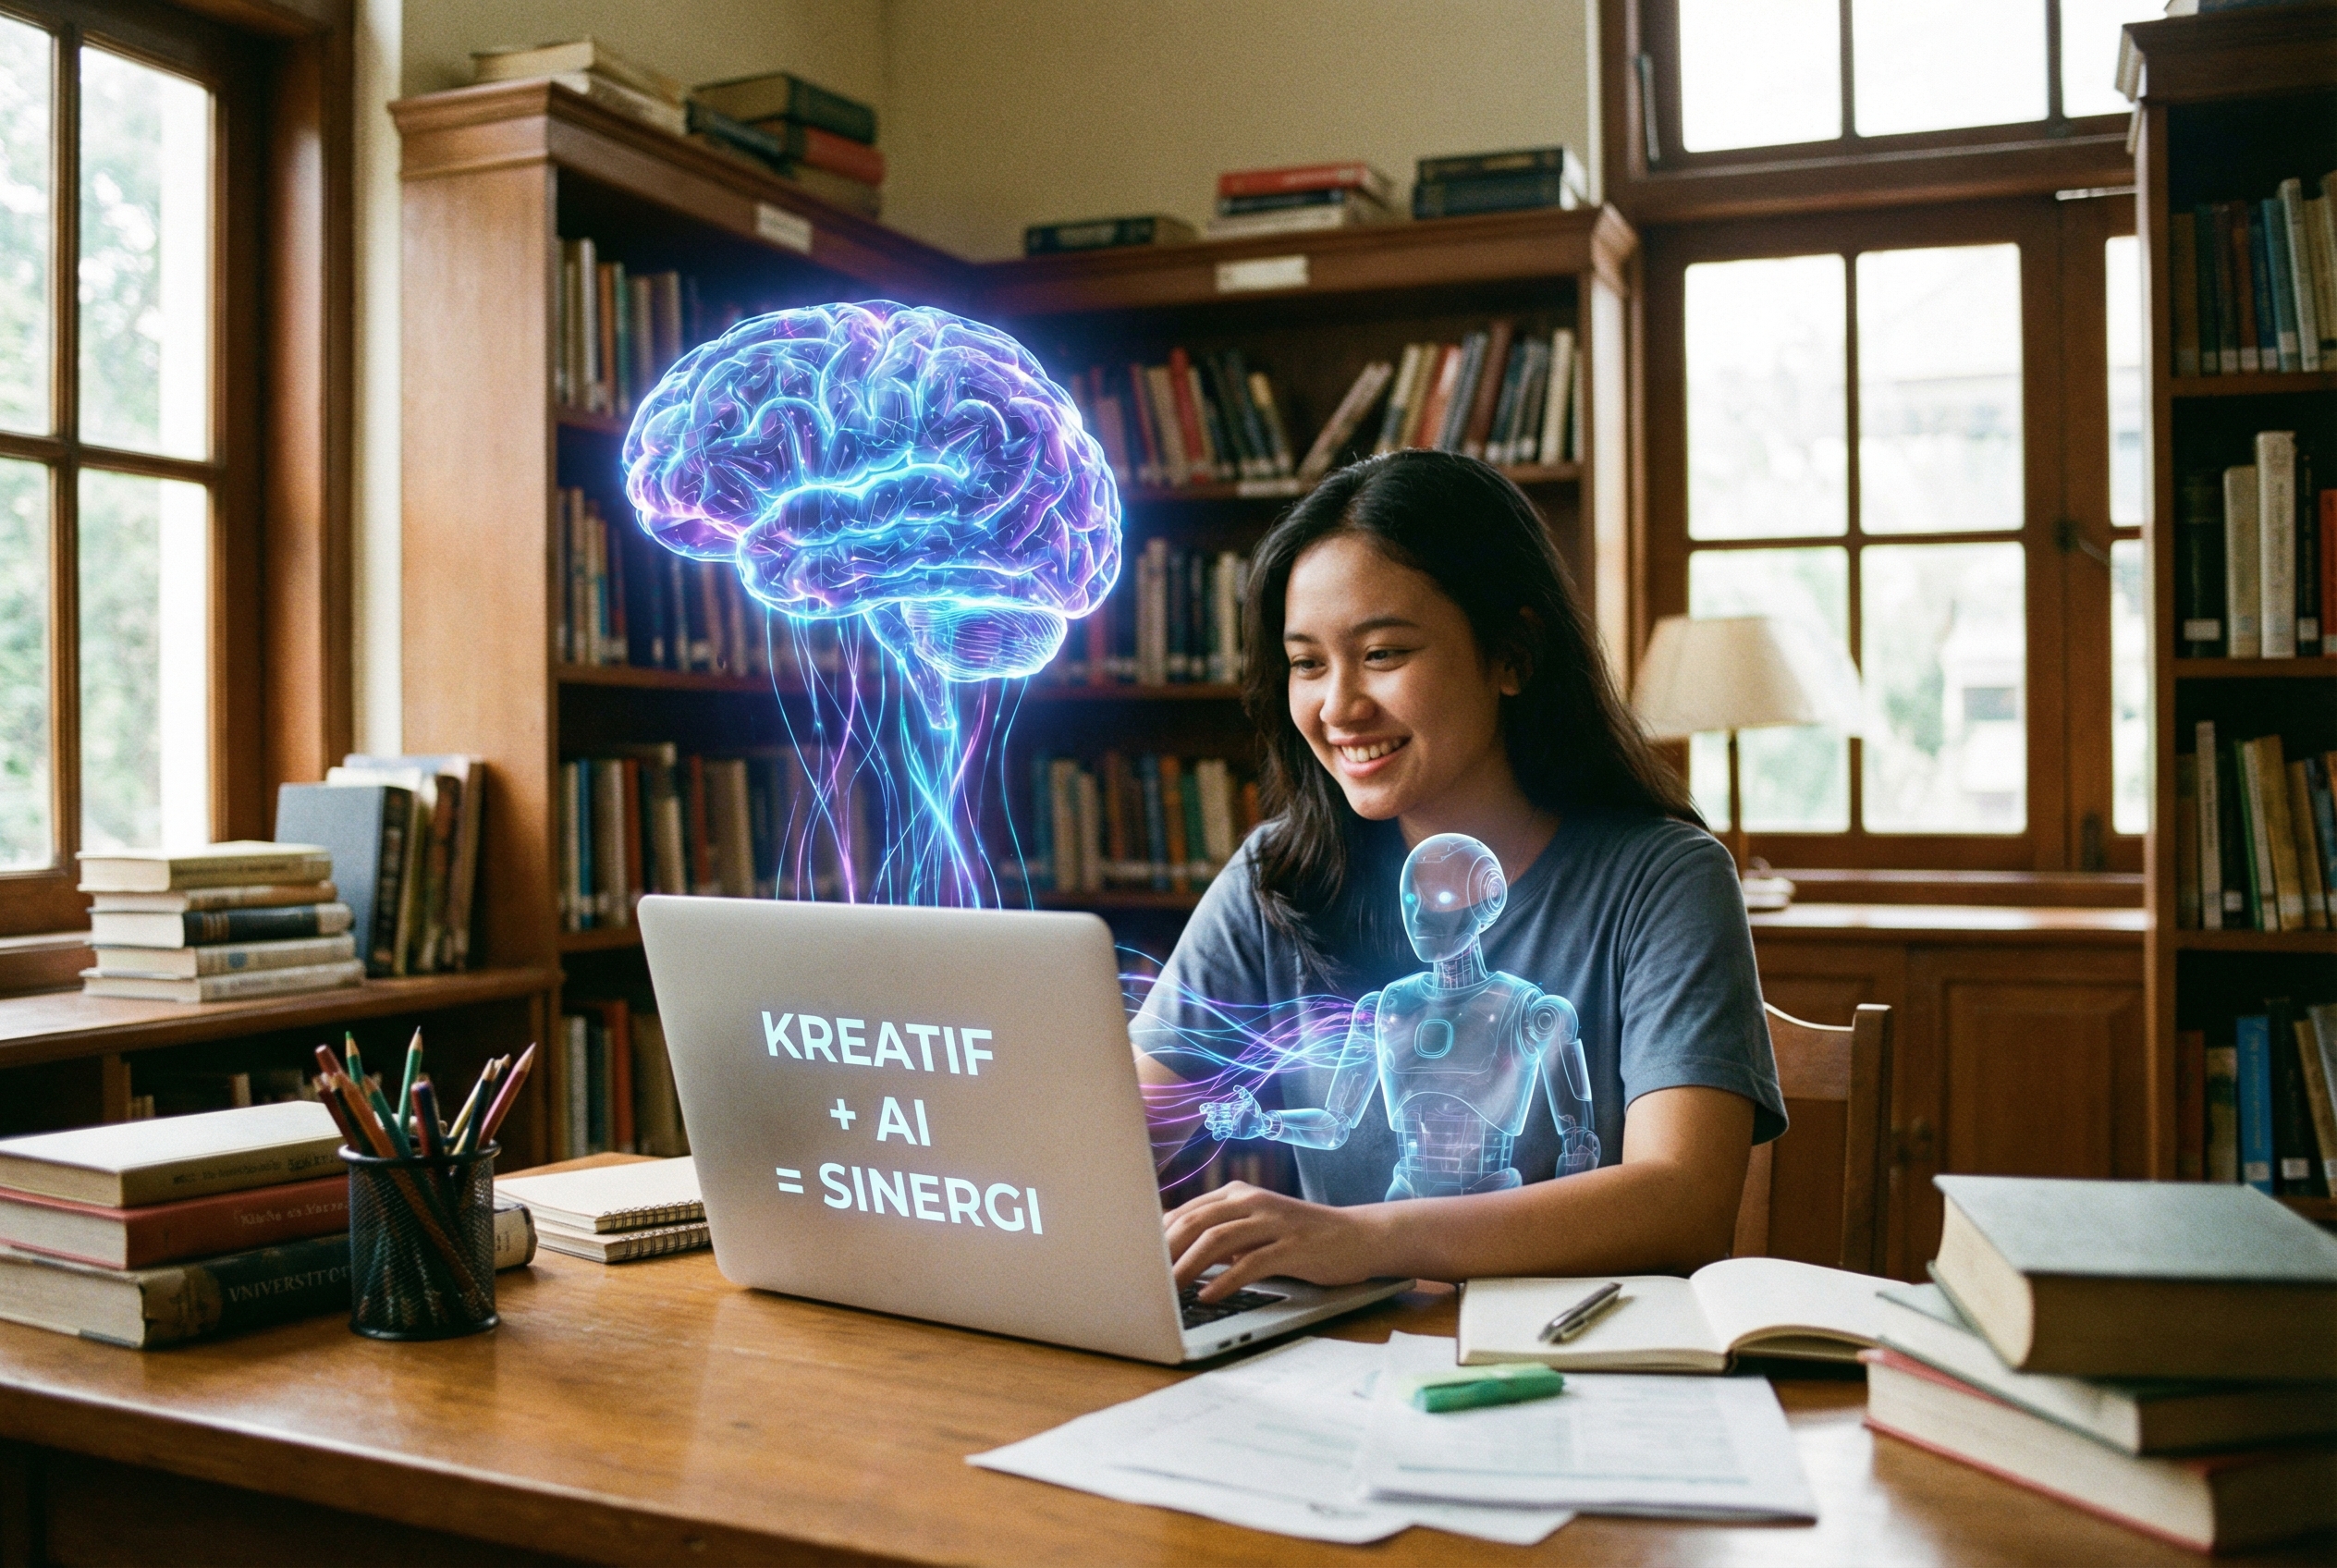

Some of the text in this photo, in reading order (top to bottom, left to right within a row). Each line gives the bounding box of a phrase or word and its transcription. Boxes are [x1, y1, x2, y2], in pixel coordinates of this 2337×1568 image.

[761, 1011, 994, 1076] KREATIF
[829, 1096, 931, 1146] + AI
[776, 1162, 1043, 1235] = SINERGI
